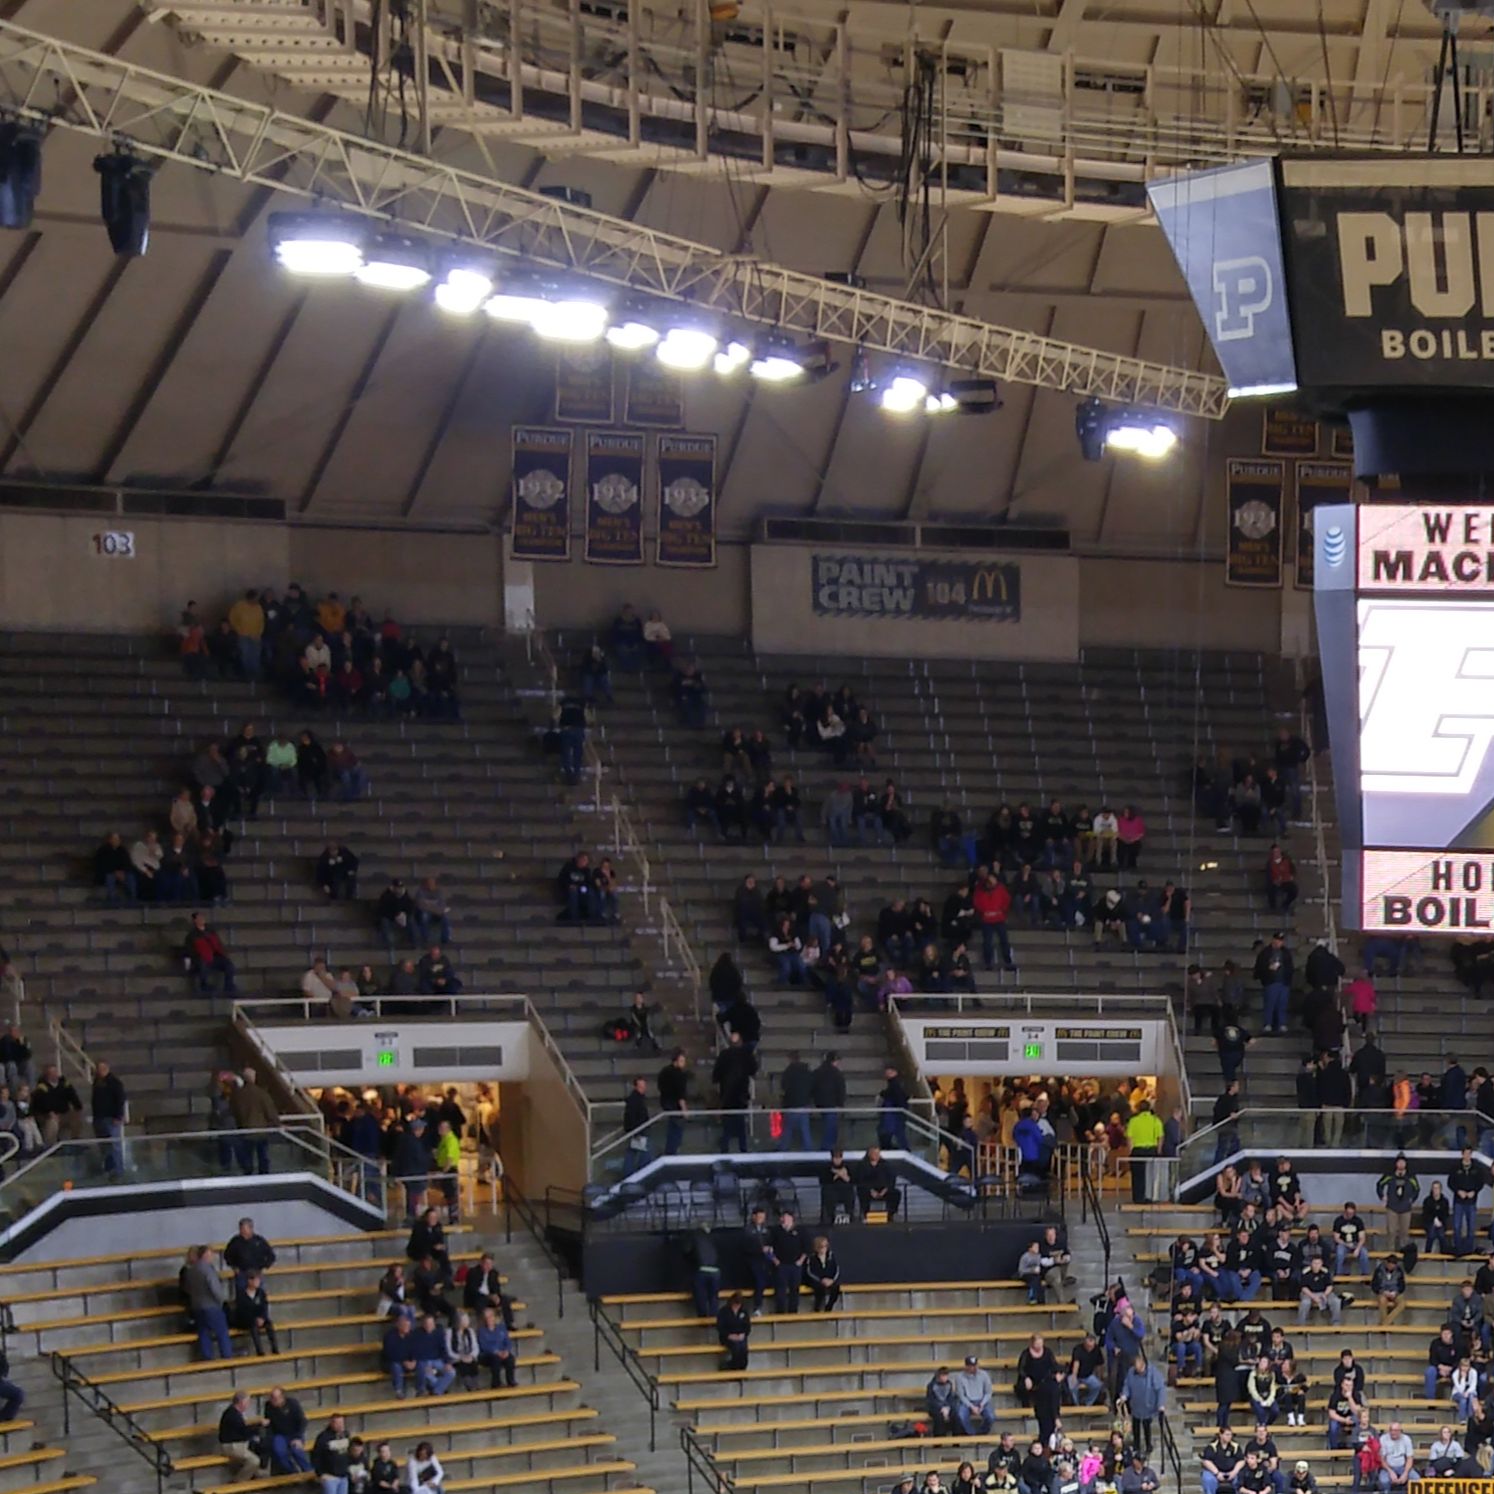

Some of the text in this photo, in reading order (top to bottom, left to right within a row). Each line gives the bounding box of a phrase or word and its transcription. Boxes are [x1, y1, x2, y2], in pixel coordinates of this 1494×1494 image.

[1213, 256, 1272, 340] P
[818, 562, 918, 586] PAINT
[818, 585, 914, 612] CREW
